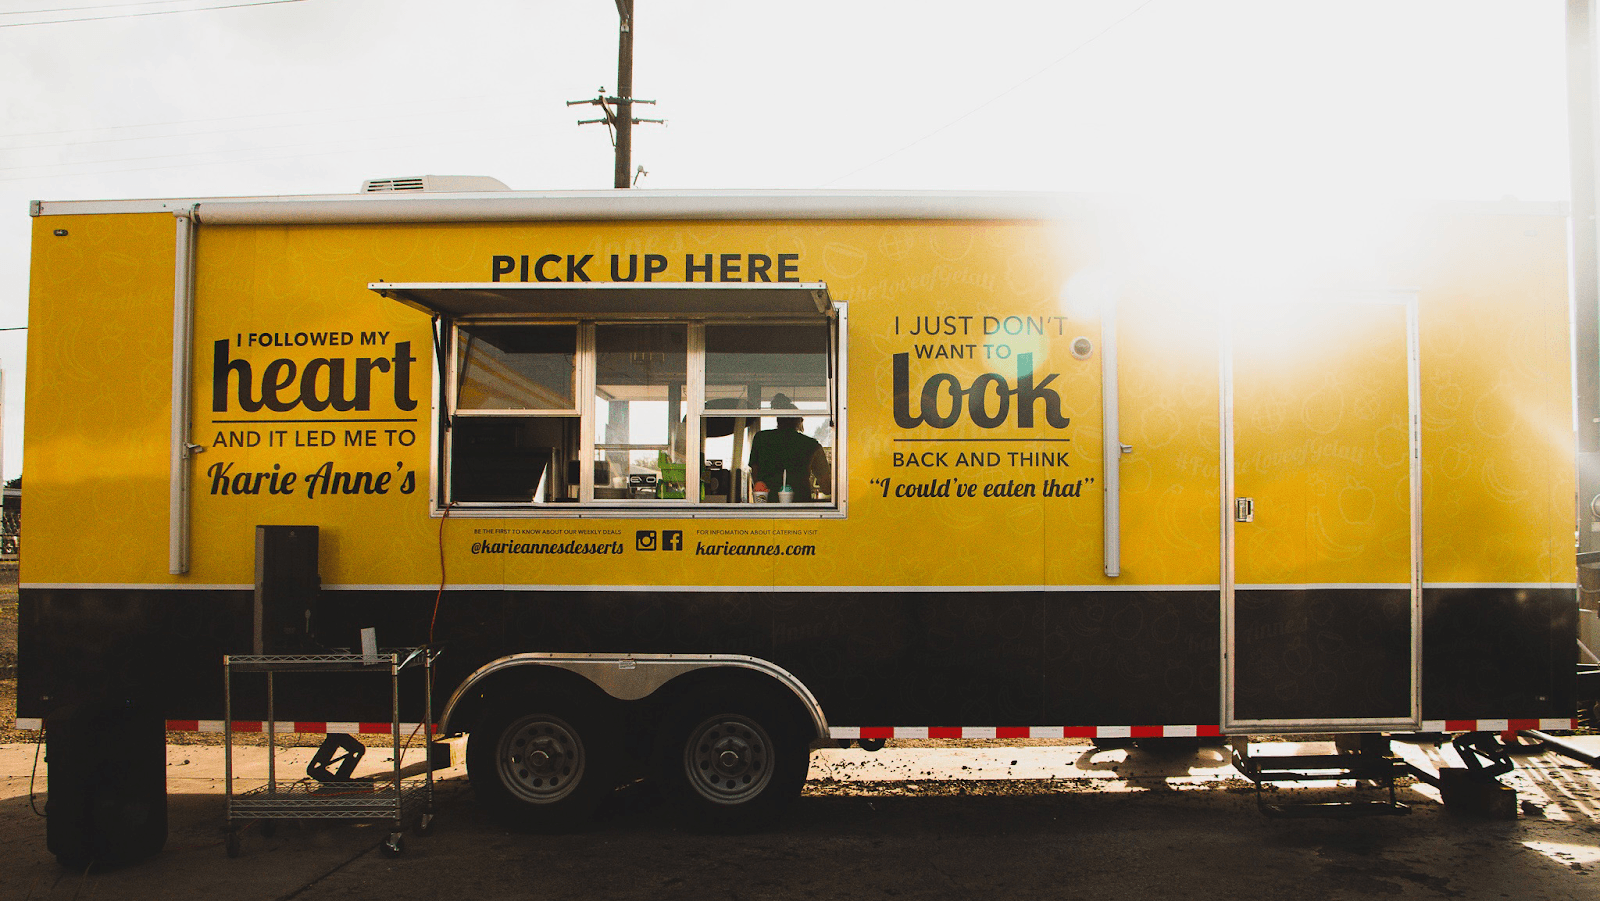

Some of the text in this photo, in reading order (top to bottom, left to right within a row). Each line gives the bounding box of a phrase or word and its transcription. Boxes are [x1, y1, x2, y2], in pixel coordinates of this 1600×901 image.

[491, 253, 800, 281] PICK UP HERE
[895, 315, 1069, 336] I JUST DON'T
[237, 331, 390, 348] I FOLLOWED MY
[914, 343, 1012, 359] WANT TO
[212, 338, 418, 413] heart
[892, 352, 1071, 430] look
[212, 429, 416, 448] AND IT LED ME TO
[893, 451, 1070, 468] BACK AND THINK
[207, 460, 416, 500] Karie Anne's
[895, 477, 978, 498] could've
[983, 479, 1036, 498] eaten
[471, 539, 624, 555] @karieannesdesserts
[695, 541, 816, 556] karieannes.com
